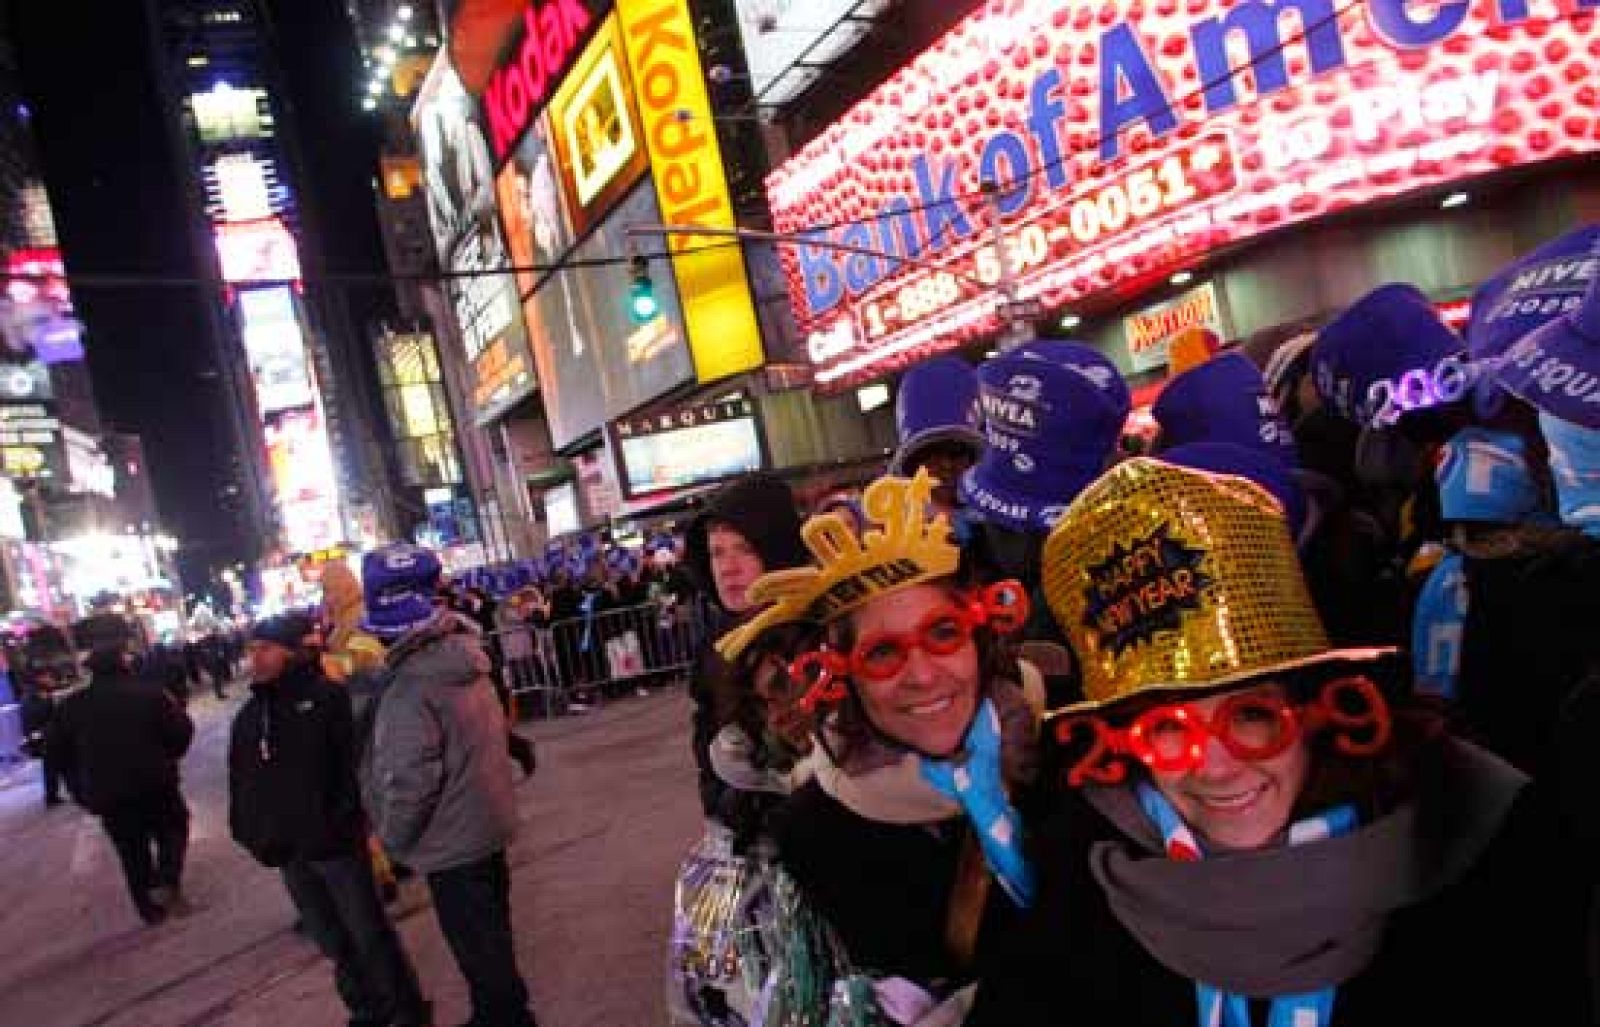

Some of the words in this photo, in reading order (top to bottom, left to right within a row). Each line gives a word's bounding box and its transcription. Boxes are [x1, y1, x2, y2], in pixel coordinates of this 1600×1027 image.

[485, 0, 590, 158] Kodak
[1350, 68, 1499, 142] Play
[630, 6, 722, 254] Kodak
[799, 154, 972, 314] Bank
[980, 68, 1068, 216] of
[980, 391, 1037, 429] NIVEA
[1098, 537, 1167, 601] HAPPY
[1129, 567, 1198, 615] YEAR
[1055, 675, 1394, 788] 2009
